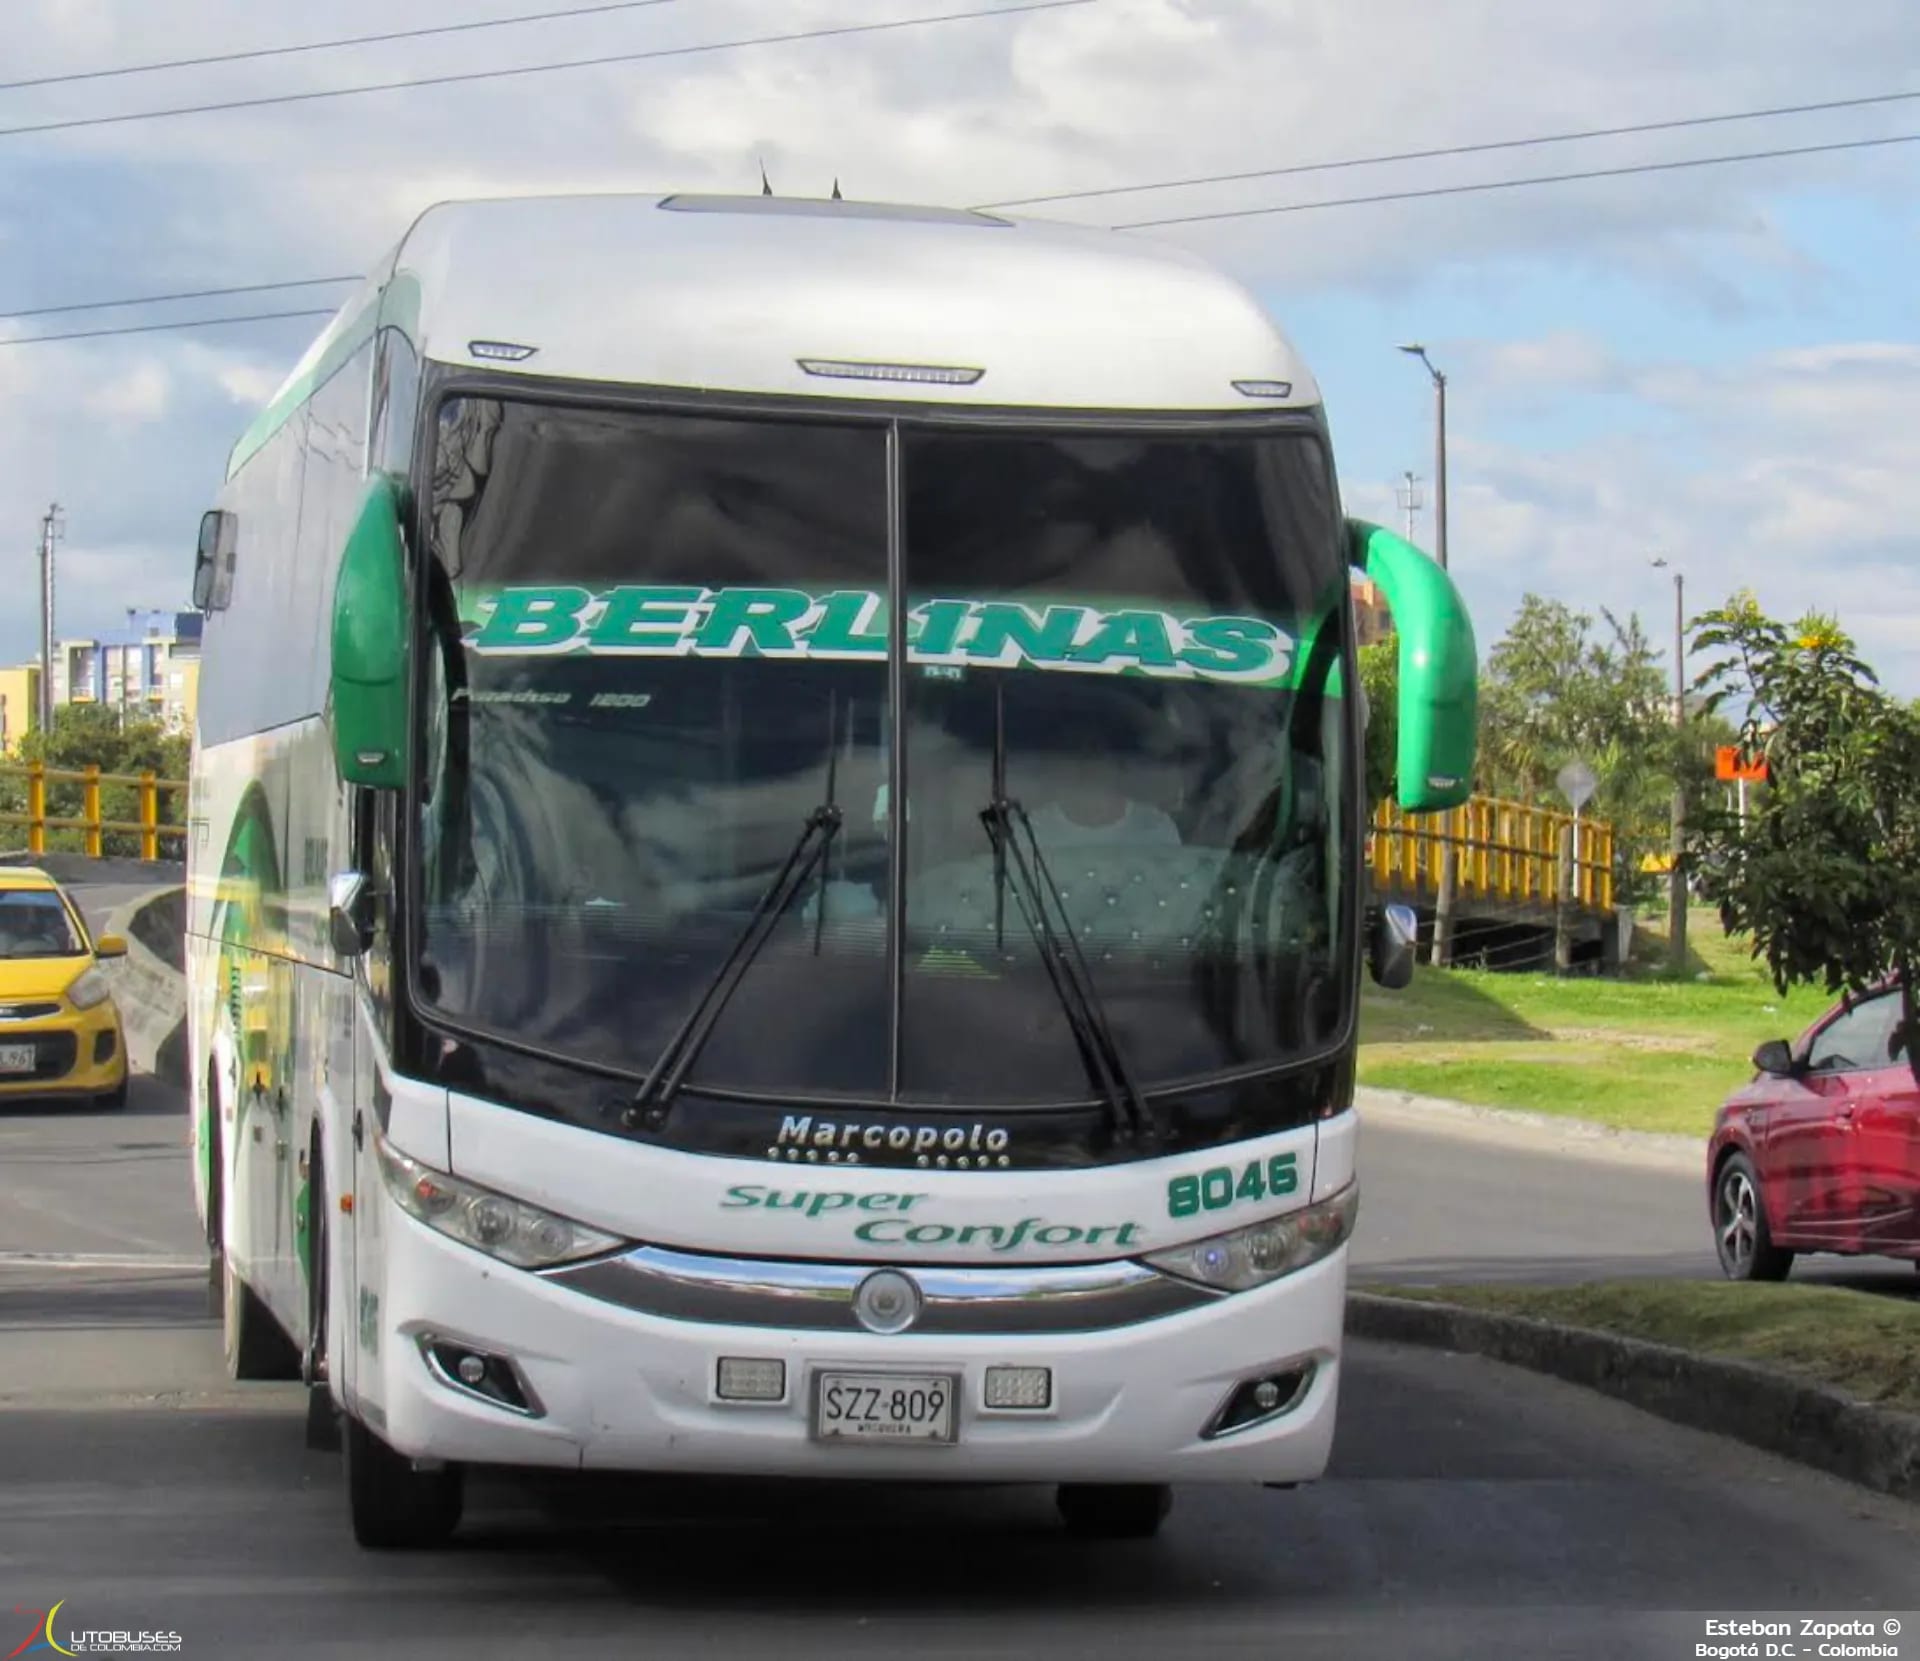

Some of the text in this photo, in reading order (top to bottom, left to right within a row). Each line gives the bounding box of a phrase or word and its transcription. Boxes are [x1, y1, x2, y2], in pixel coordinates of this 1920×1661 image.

[462, 585, 1290, 682] BERLINAS
[777, 1115, 1010, 1152] Marcopolo
[720, 1183, 928, 1218] Super
[1166, 1151, 1298, 1218] 8046
[855, 1216, 1146, 1249] Confort
[826, 1386, 945, 1422] SZZ-809
